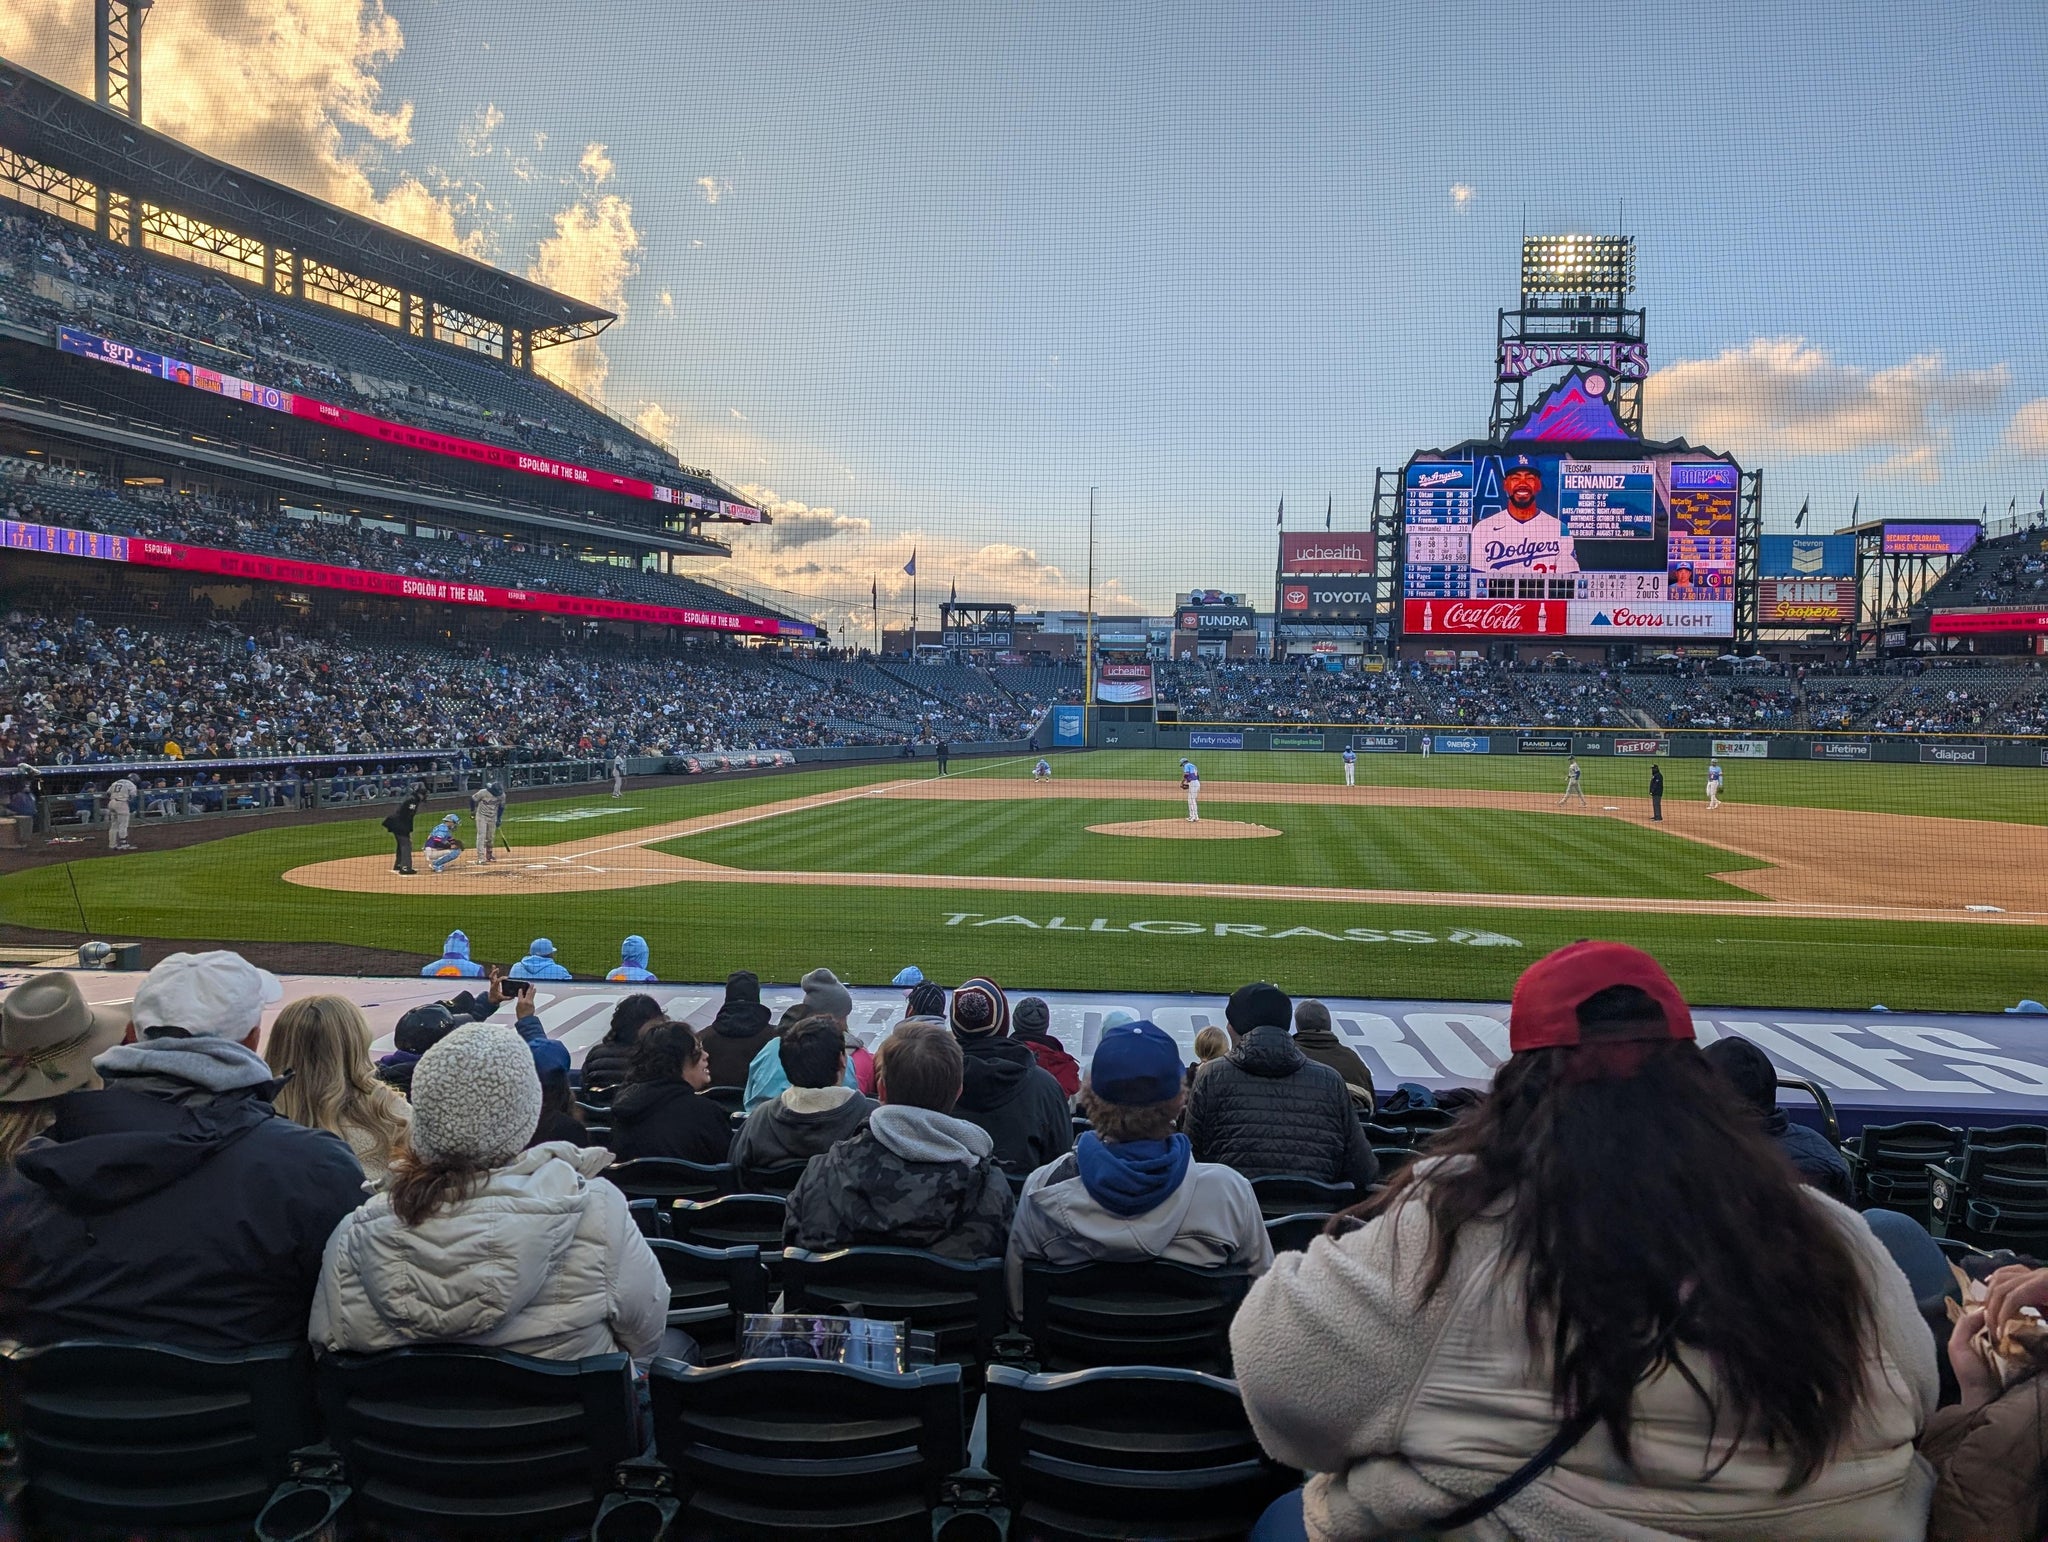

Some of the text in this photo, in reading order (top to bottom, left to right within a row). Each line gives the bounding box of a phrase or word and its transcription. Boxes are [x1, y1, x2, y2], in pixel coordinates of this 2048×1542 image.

[103, 340, 134, 362] tgrp
[85, 351, 100, 360] YOUR
[100, 354, 130, 368] ACCOUNTING
[1500, 342, 1650, 378] ROCKIES
[551, 465, 559, 476] AT
[561, 467, 573, 479] THE
[574, 470, 590, 482] BAR.
[1565, 464, 1649, 473] TEOSCAR 37 LF
[1564, 475, 1626, 489] HERNANDEZ
[12, 533, 32, 548] 17.1
[1886, 534, 1910, 542] BECAUSE
[48, 538, 54, 551] 5
[69, 540, 75, 553] 4
[90, 543, 96, 555] 3
[1894, 543, 1950, 551] HAS ONE CHALLENGE
[112, 546, 122, 558] 12
[1296, 544, 1361, 560] uchealth
[1484, 537, 1560, 568] Dodgers
[1723, 576, 1732, 584] 10
[438, 585, 447, 598] AT
[450, 586, 466, 600] THE
[467, 588, 487, 602] BAR.
[1312, 592, 1372, 603] TOYOTA
[1637, 591, 1659, 599] 2 OUTS
[1776, 584, 1838, 602] KING
[1775, 602, 1838, 618] Soopers
[718, 616, 728, 627] THE
[728, 617, 741, 628] BAR.
[1199, 615, 1248, 626] TUNDRA
[1443, 603, 1523, 630] Coca-Cola
[1613, 607, 1664, 626] Coors
[1885, 633, 1905, 642] PLATTE
[1108, 666, 1146, 676] uchealth
[1192, 736, 1241, 746] xfinity mobile
[1734, 743, 1750, 751] 24/7
[1826, 744, 1867, 754] Lifetime
[1935, 750, 1975, 761] dialpad
[942, 913, 1438, 944] TALLGRASS
